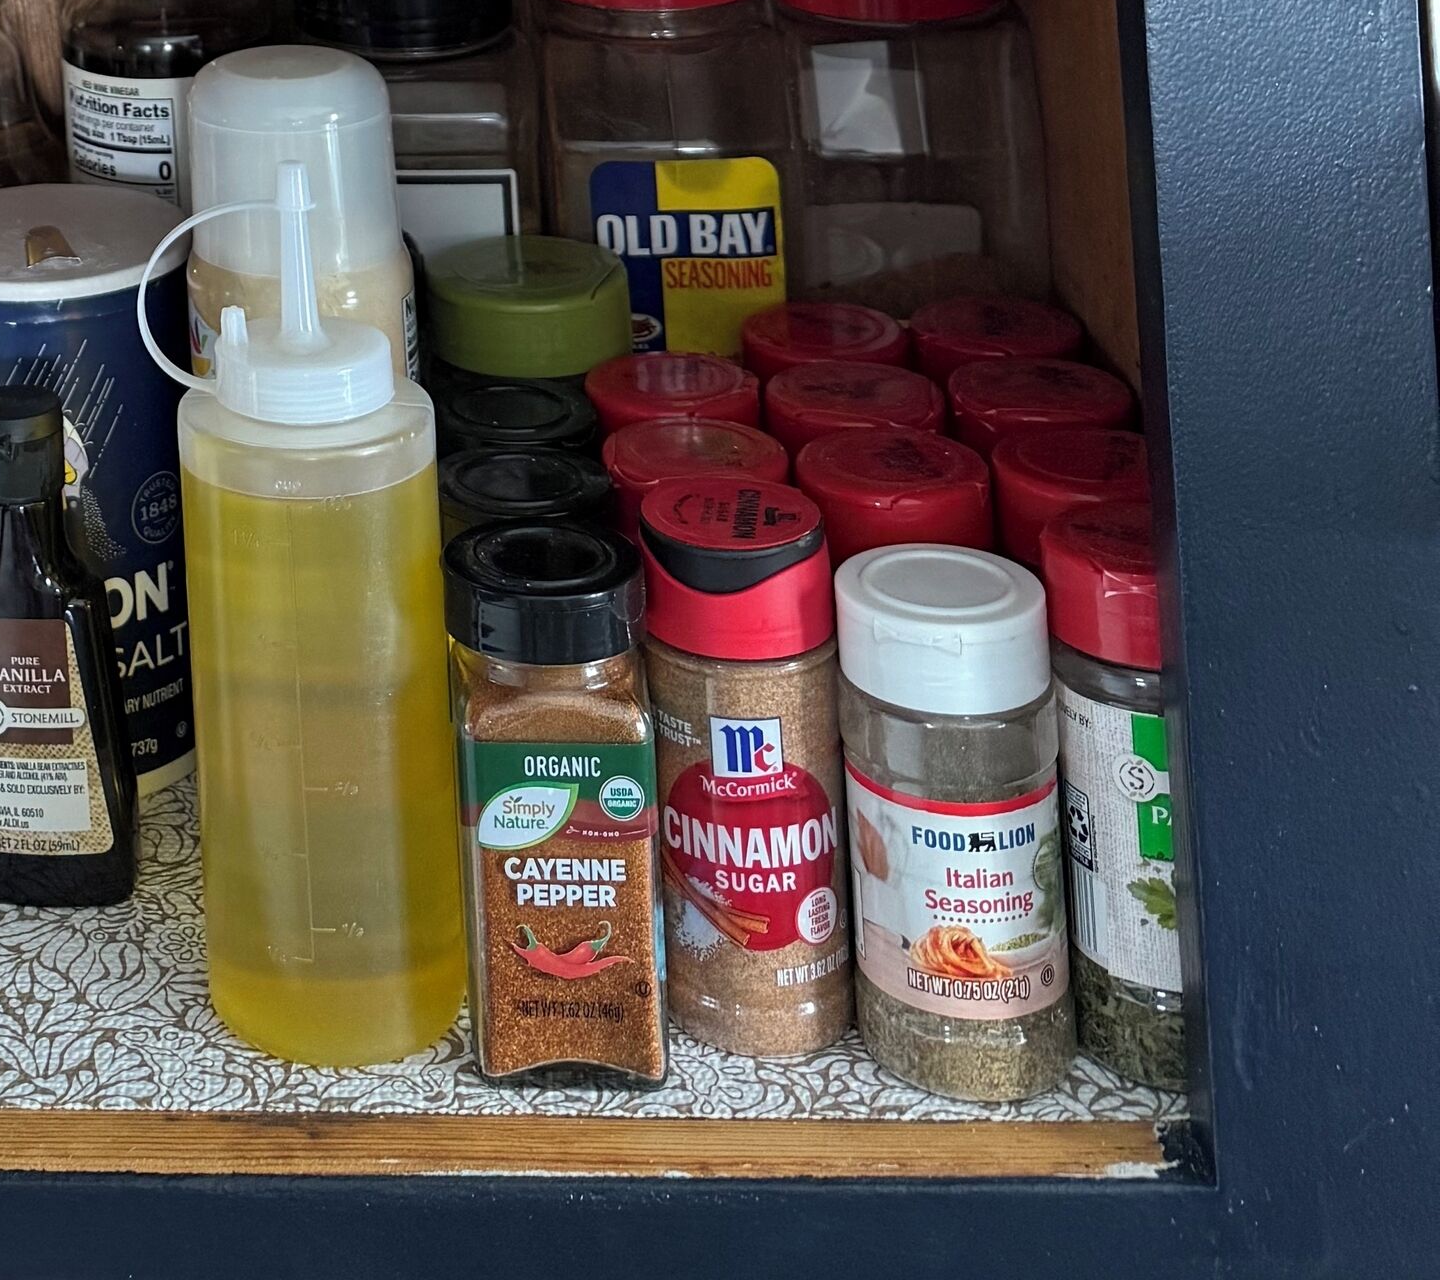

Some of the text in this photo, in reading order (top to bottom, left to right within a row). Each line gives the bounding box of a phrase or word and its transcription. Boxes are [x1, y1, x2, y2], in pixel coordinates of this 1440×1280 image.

[123, 102, 170, 118] Facts
[597, 212, 768, 256] OLD BAY
[665, 260, 772, 289] SEASONING
[11, 657, 40, 666] PURE
[3, 684, 51, 694] EXTRACT
[142, 678, 184, 709] NUTRIENT
[657, 709, 692, 735] TASTE
[130, 738, 158, 757] 737g
[524, 756, 601, 777] ORGANIC
[611, 788, 634, 796] USDA
[503, 800, 555, 818] Simply
[494, 815, 546, 829] Nature
[664, 805, 838, 869] CINNAMON
[912, 823, 1035, 851] FOOD LION
[504, 857, 627, 881] CAYENNE
[946, 868, 1014, 888] Italian
[715, 870, 796, 893] SUGAR
[517, 883, 616, 907] PEPPER
[925, 889, 1033, 913] Seasoning
[907, 968, 1030, 1003] NET WT 0.75 OZ (21g)
